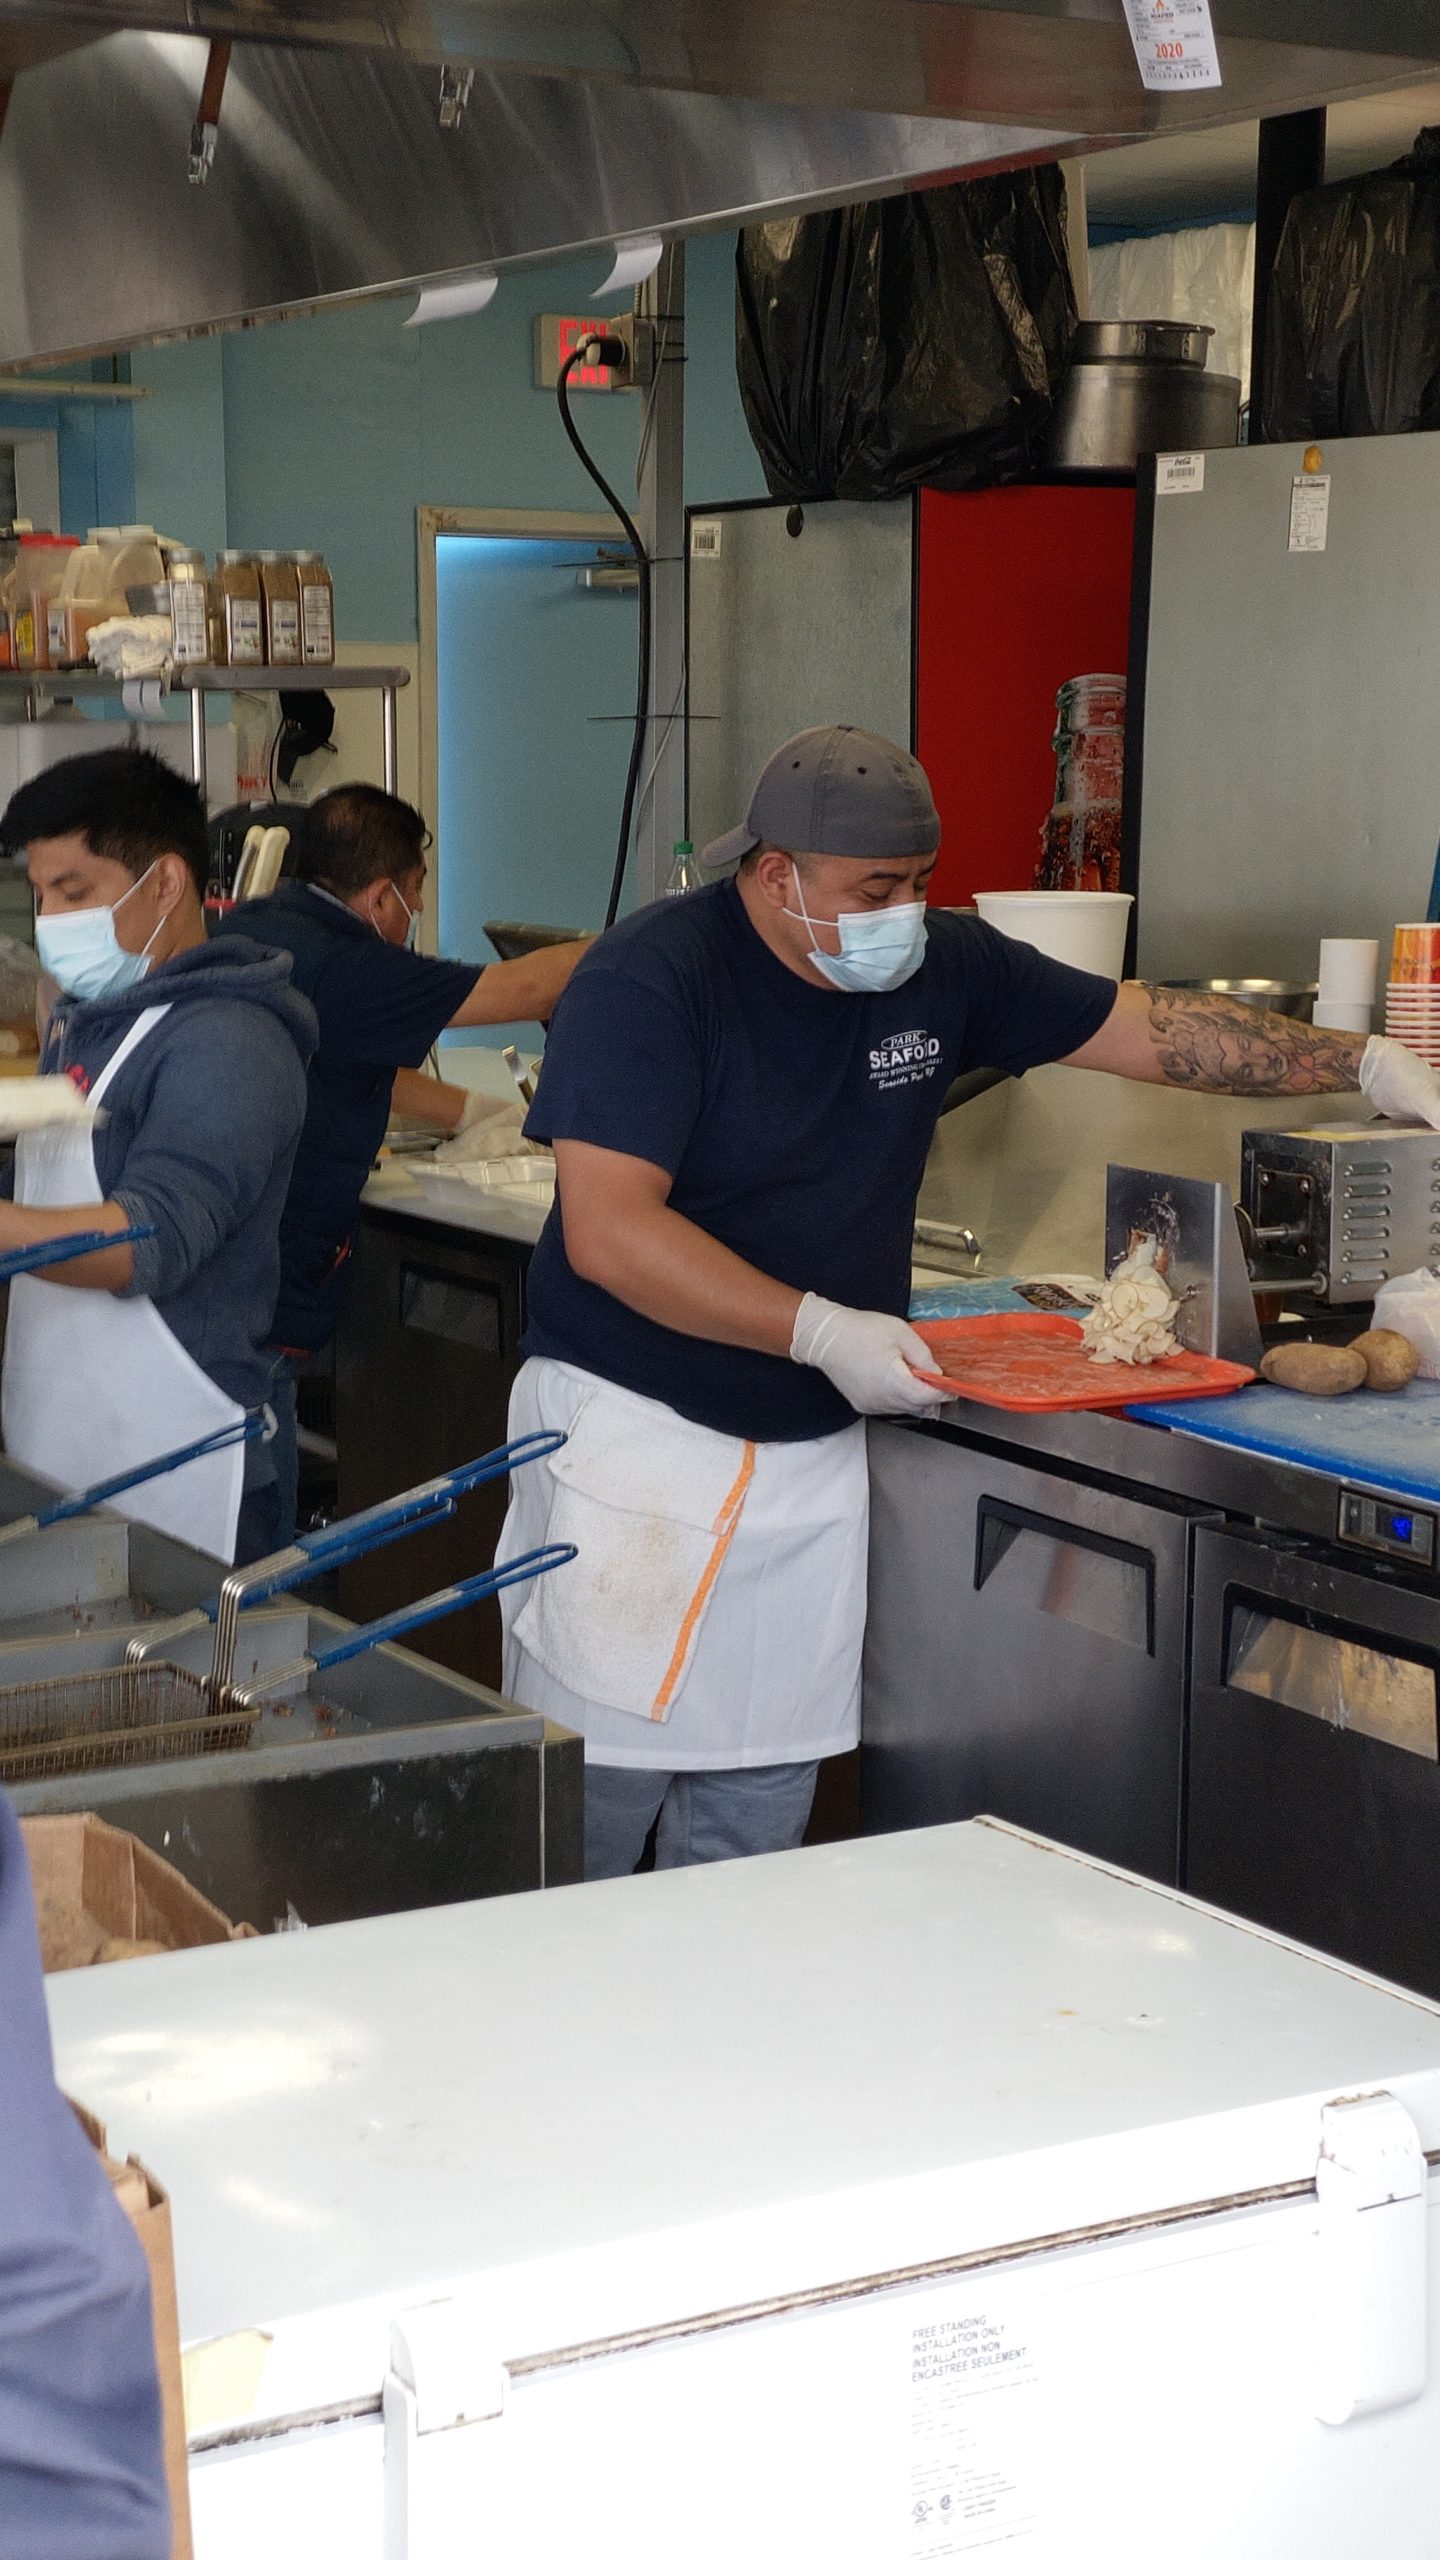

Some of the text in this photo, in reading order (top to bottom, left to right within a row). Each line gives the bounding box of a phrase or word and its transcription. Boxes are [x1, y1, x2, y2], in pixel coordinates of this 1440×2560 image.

[1155, 42, 1184, 59] 2020
[890, 1032, 921, 1049] PARK
[912, 2314, 987, 2340] FREE STANDING
[912, 2324, 1005, 2353] INSTALLATION ONLY
[911, 2360, 969, 2383] ENCASTREE
[971, 2347, 1027, 2369] SEULEMENT
[912, 2341, 1001, 2369] INSTALLATION NON
